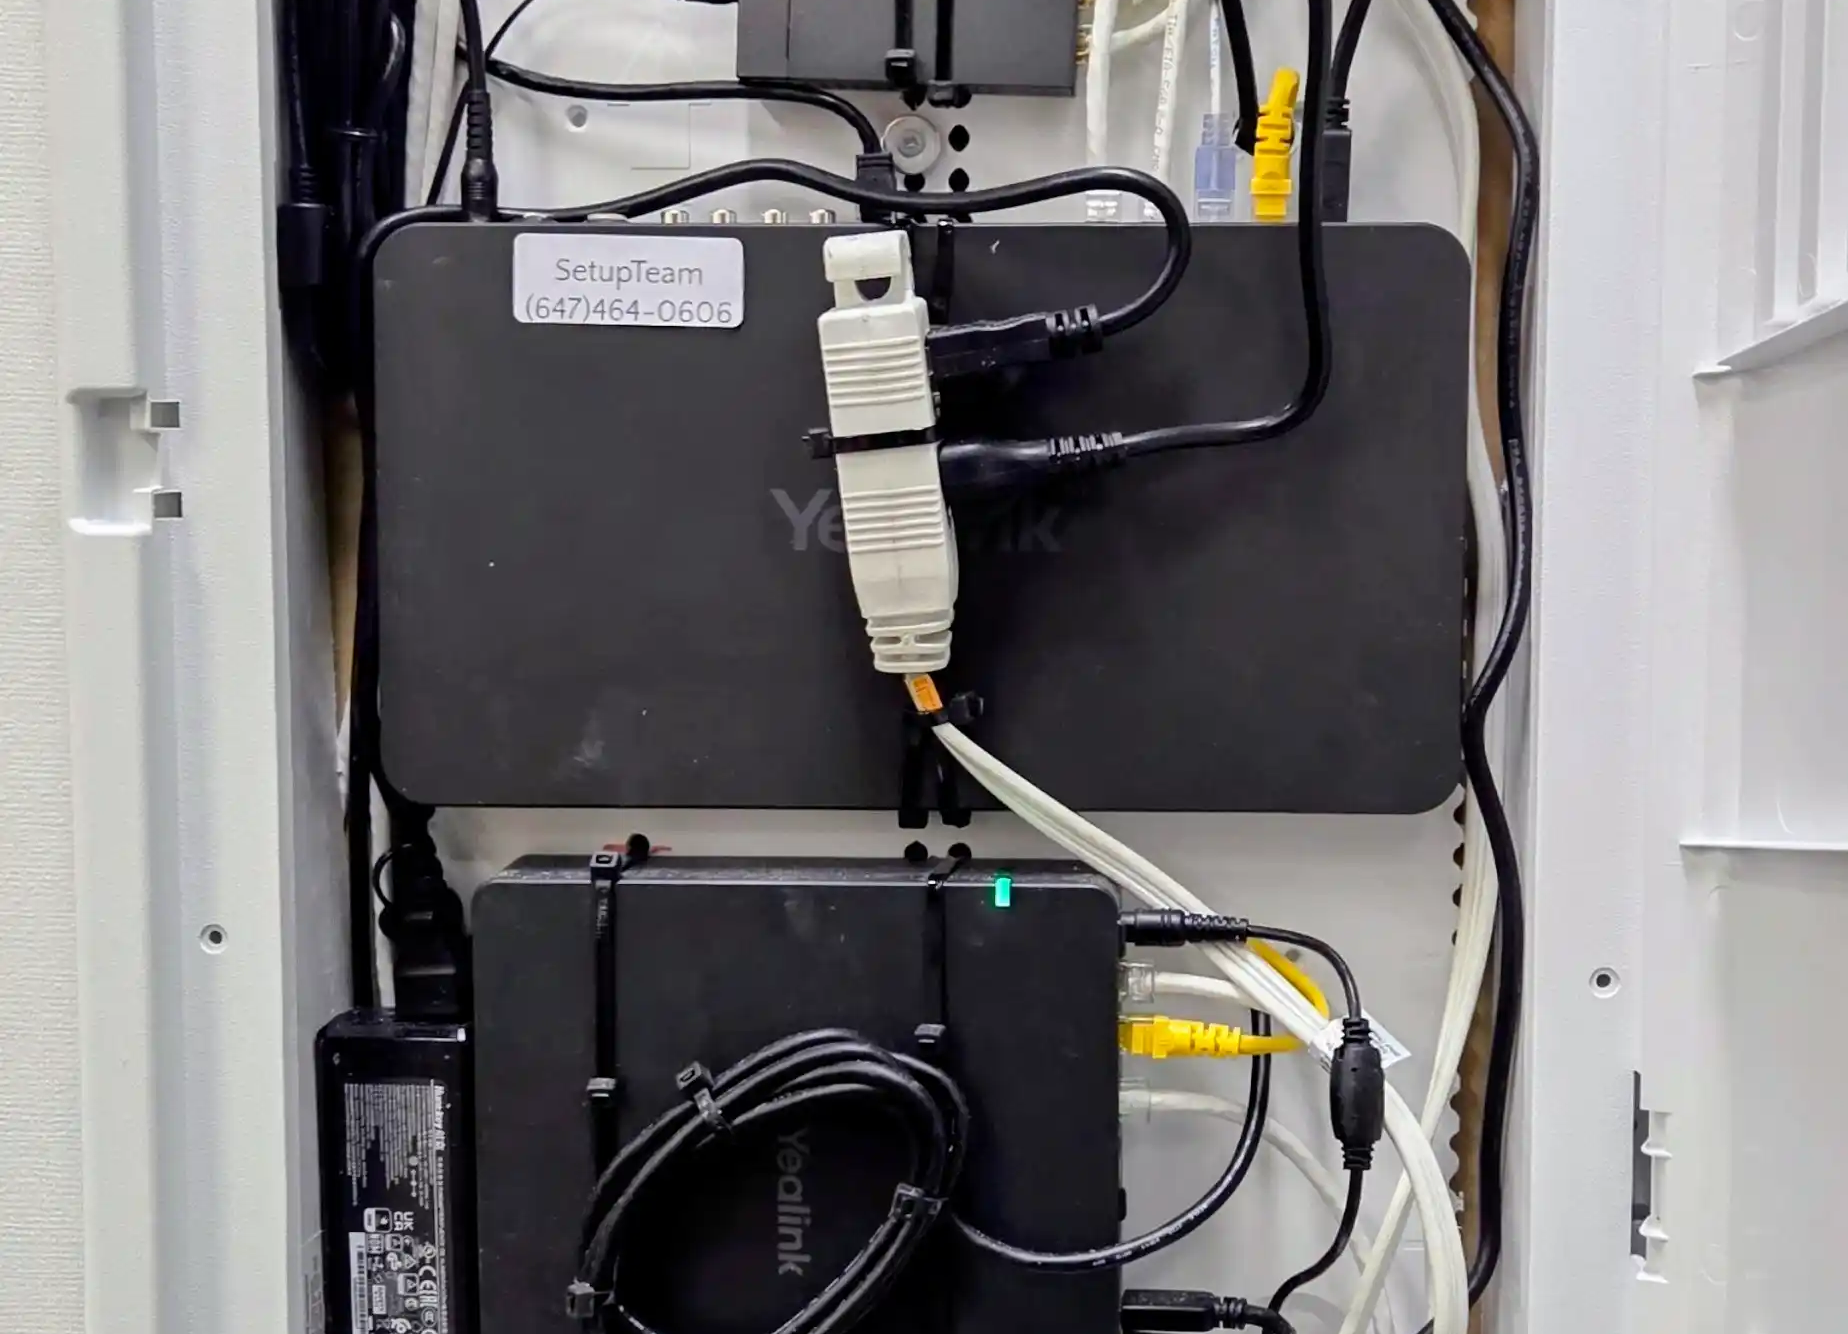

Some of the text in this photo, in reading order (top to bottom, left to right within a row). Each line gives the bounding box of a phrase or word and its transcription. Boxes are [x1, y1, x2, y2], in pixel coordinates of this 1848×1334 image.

[554, 257, 703, 290] SetupTeam
[525, 294, 733, 323] (647)464-0606
[776, 1126, 813, 1277] Yealink
